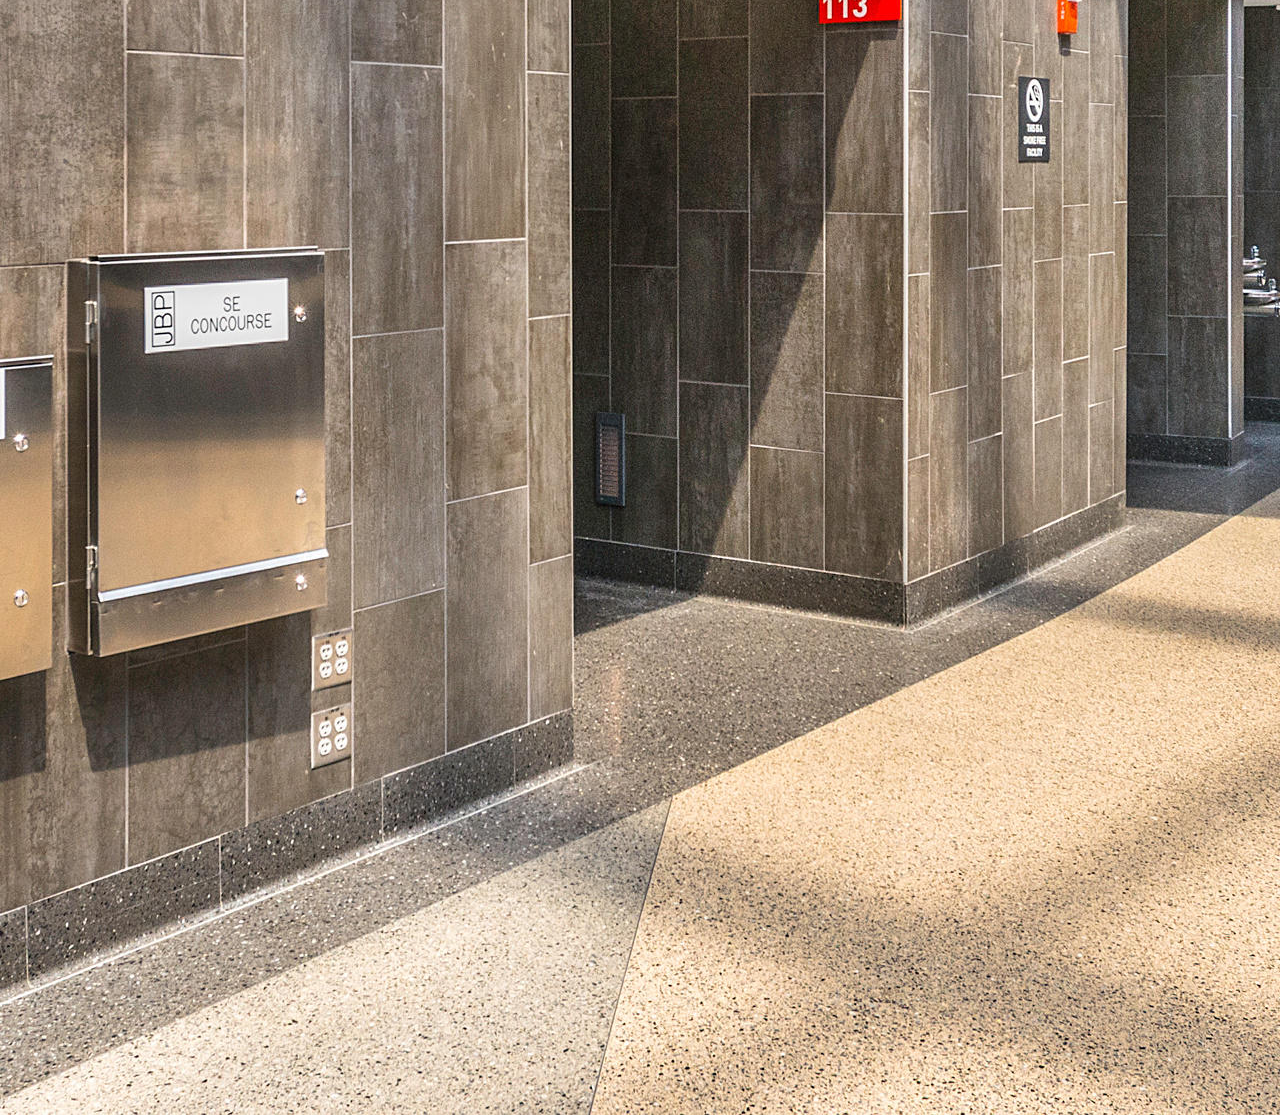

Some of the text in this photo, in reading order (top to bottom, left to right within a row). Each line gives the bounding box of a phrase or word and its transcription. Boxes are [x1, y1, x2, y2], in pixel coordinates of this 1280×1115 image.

[223, 296, 240, 313] SE
[154, 294, 173, 344] JBP
[190, 313, 272, 335] CONCOURSE
